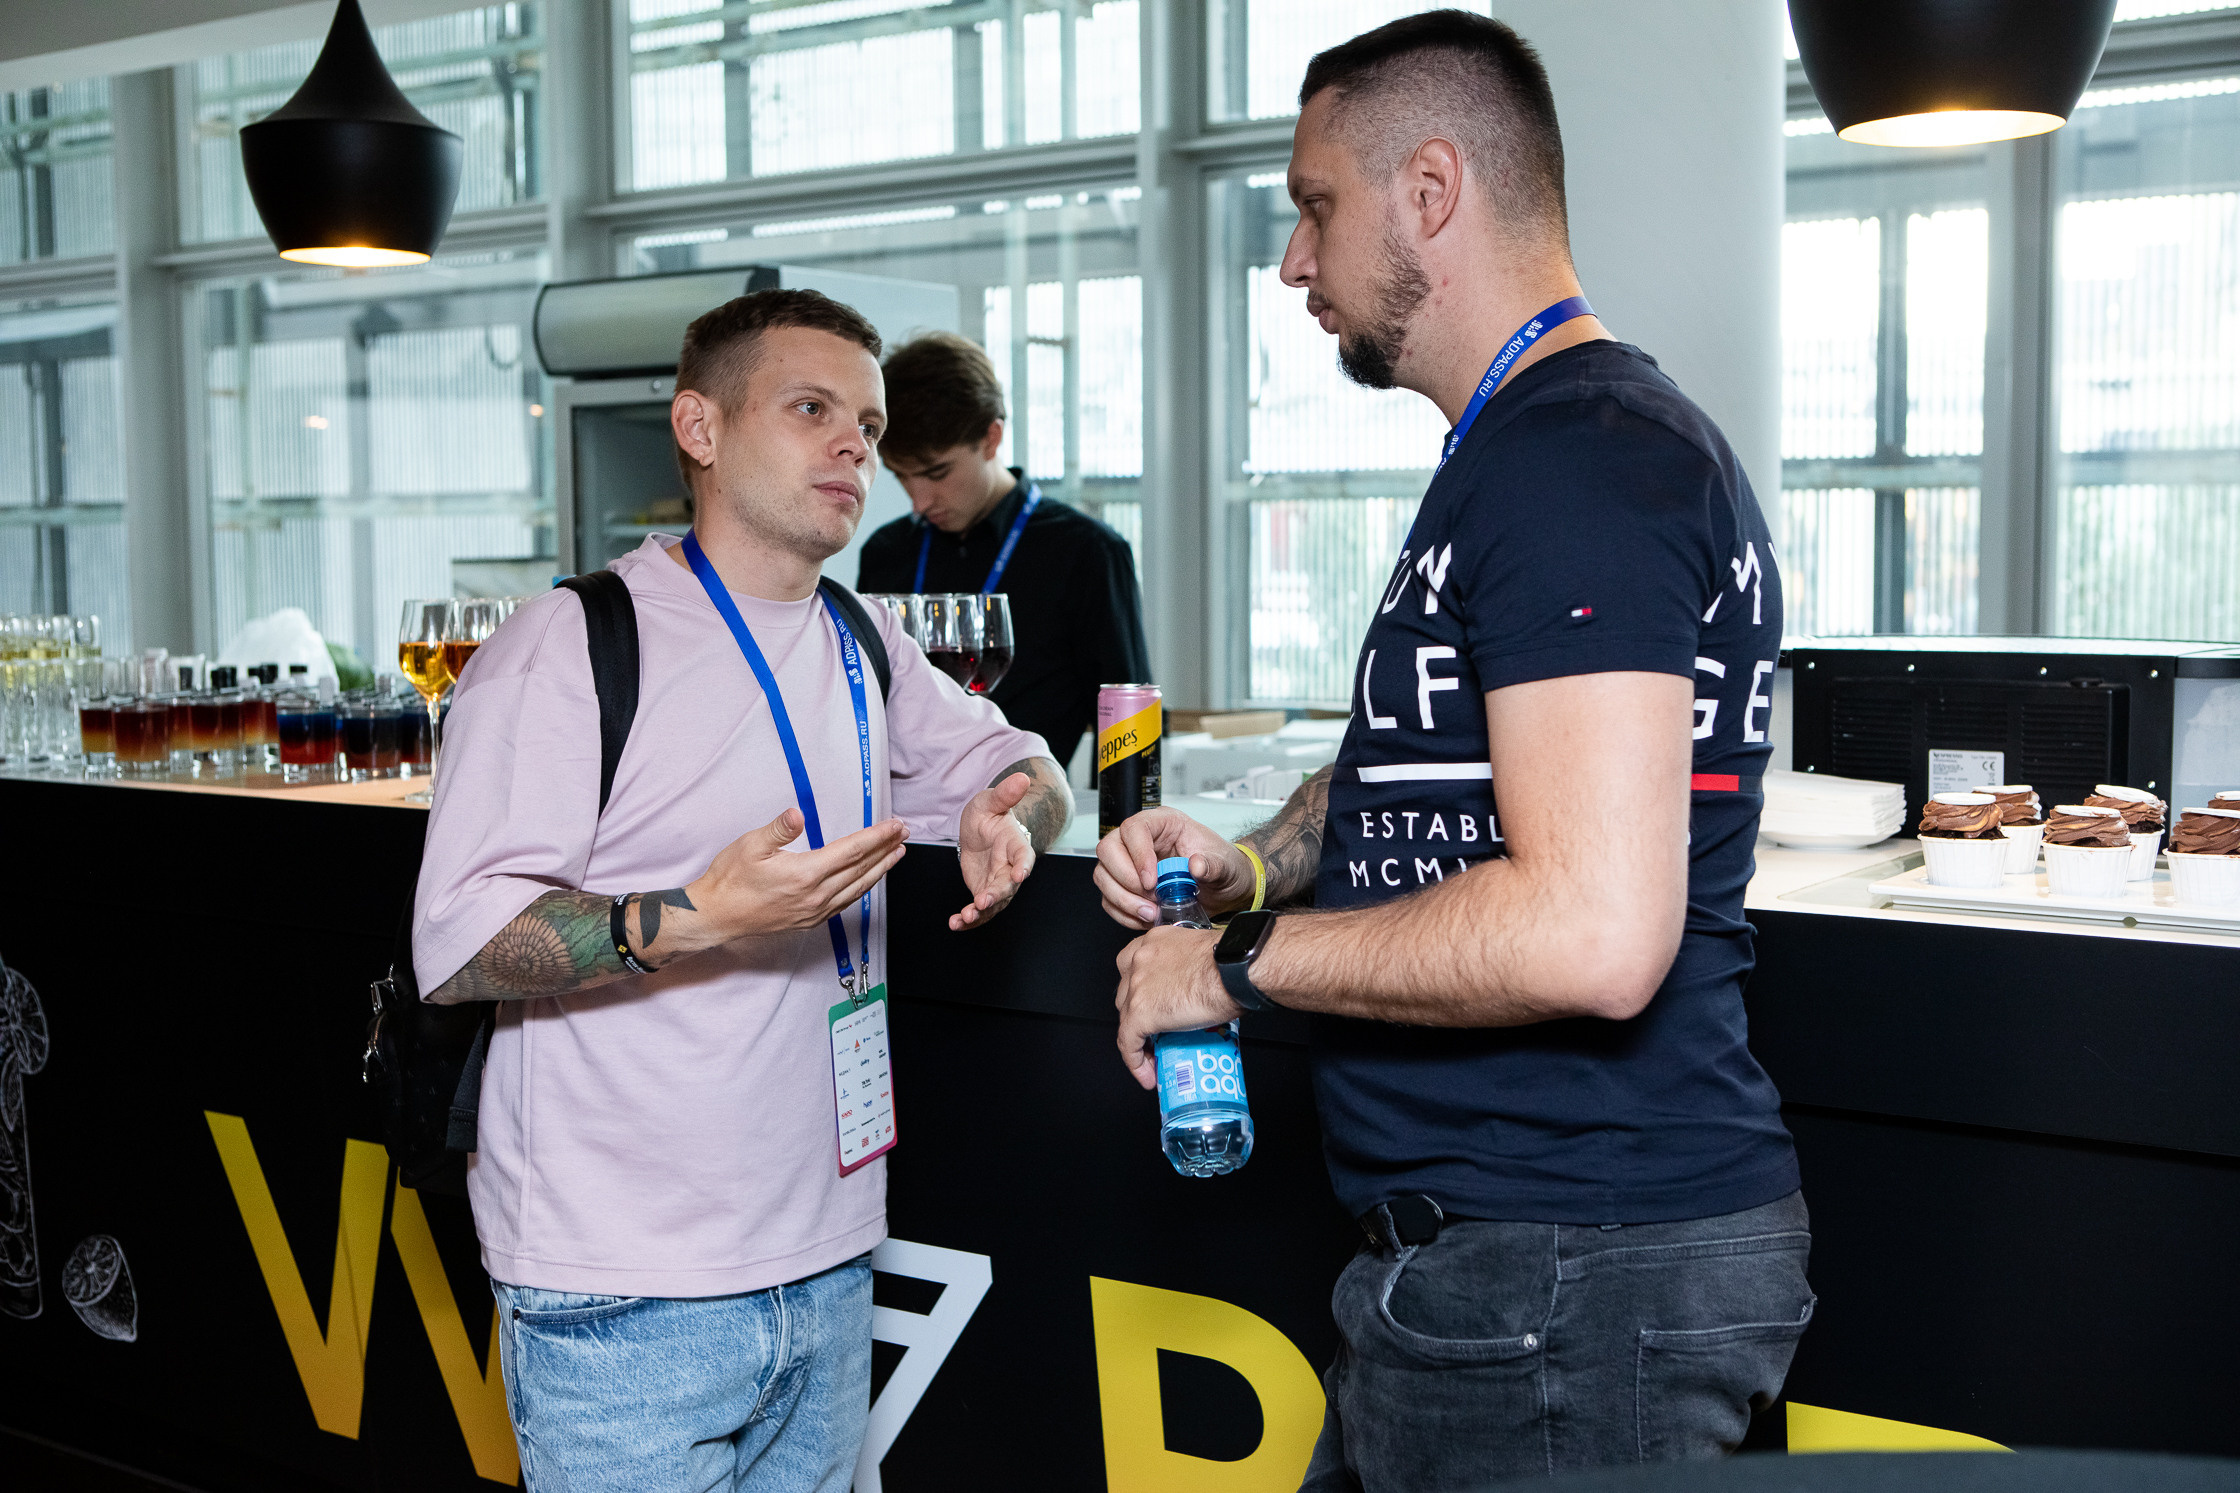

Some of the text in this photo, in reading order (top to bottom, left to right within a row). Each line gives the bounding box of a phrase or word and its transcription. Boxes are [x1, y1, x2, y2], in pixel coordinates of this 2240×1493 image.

[1478, 335, 1525, 397] ADPASS.RU
[836, 618, 858, 666] ADPASS.RU
[859, 720, 871, 777] ADPASS.RU
[1359, 811, 1505, 843] ESTABL
